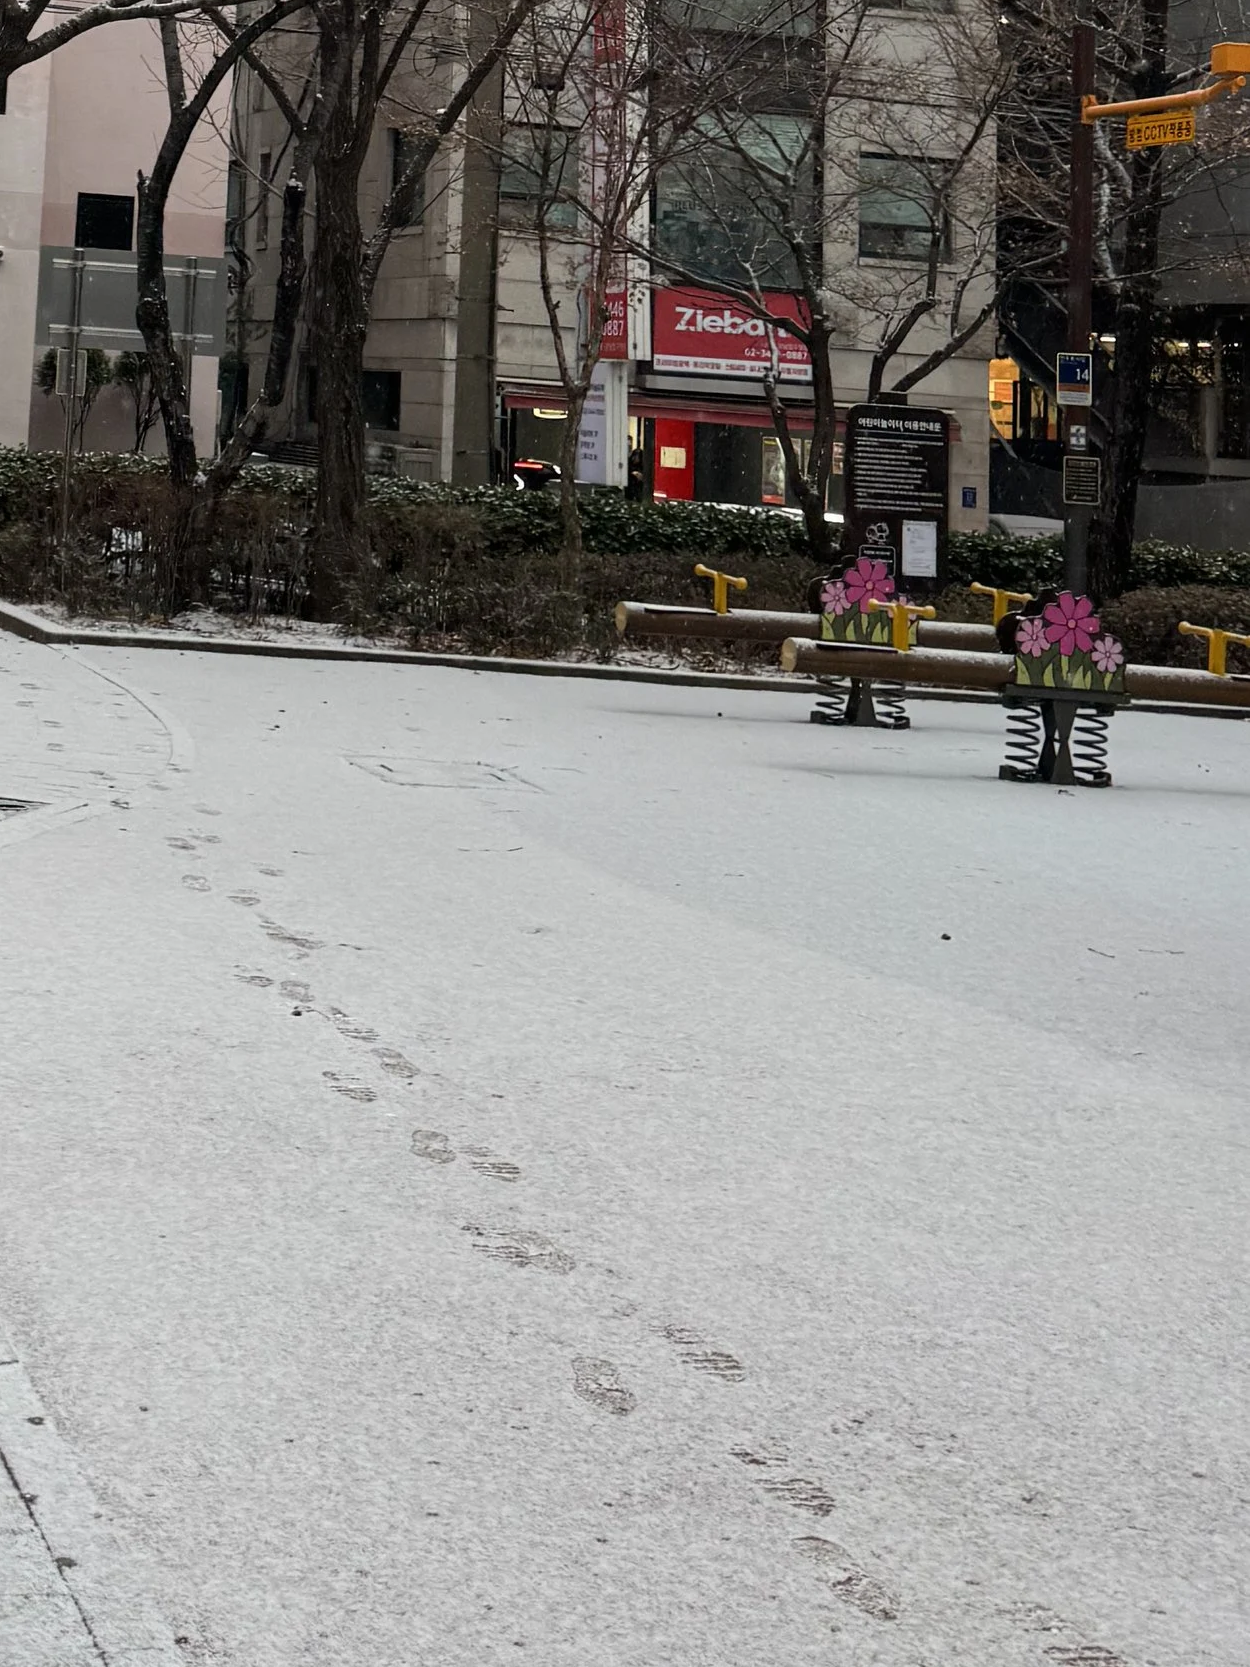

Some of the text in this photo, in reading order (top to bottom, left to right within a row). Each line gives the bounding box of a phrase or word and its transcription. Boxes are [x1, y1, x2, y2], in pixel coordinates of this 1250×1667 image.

[674, 306, 790, 338] Zieba
[744, 347, 808, 361] 02-34-0887
[1076, 368, 1089, 382] 14
[857, 417, 942, 432] 어린이놀이터 이용안내문
